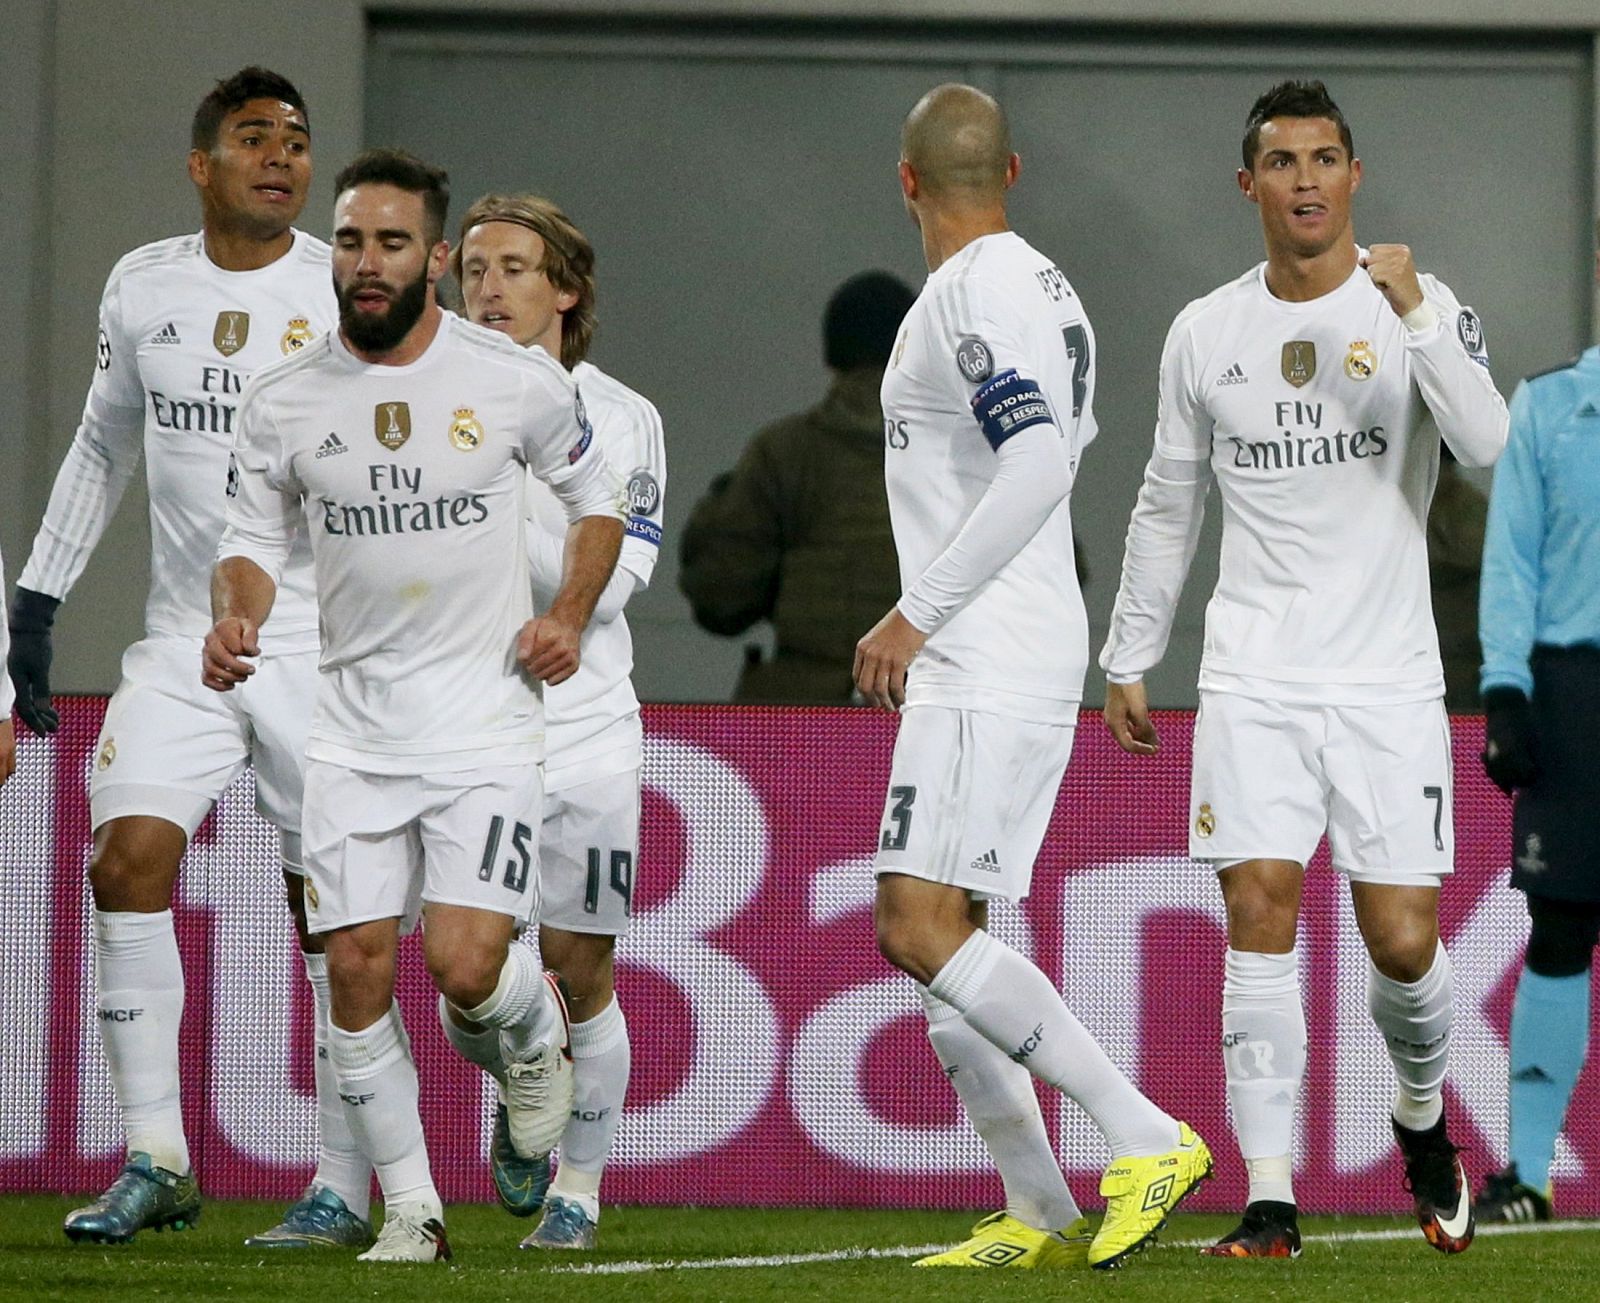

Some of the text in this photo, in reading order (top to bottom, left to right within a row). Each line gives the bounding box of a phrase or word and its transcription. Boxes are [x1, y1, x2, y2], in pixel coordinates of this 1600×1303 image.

[151, 337, 181, 345] adidas
[969, 358, 986, 375] 10
[1216, 376, 1248, 387] adidas
[988, 404, 1003, 418] NO
[1001, 396, 1017, 409] TO
[1275, 400, 1322, 429] Fly
[315, 445, 349, 459] adidas
[1228, 426, 1388, 469] Emirates
[368, 464, 422, 494] Fly
[634, 495, 649, 508] 10
[319, 494, 488, 536] Emirates
[625, 521, 662, 542] RESPECT
[881, 785, 917, 851] 3
[1423, 786, 1445, 851] 7
[478, 815, 532, 894] 15
[970, 861, 1001, 873] adidas
[584, 847, 632, 917] 19
